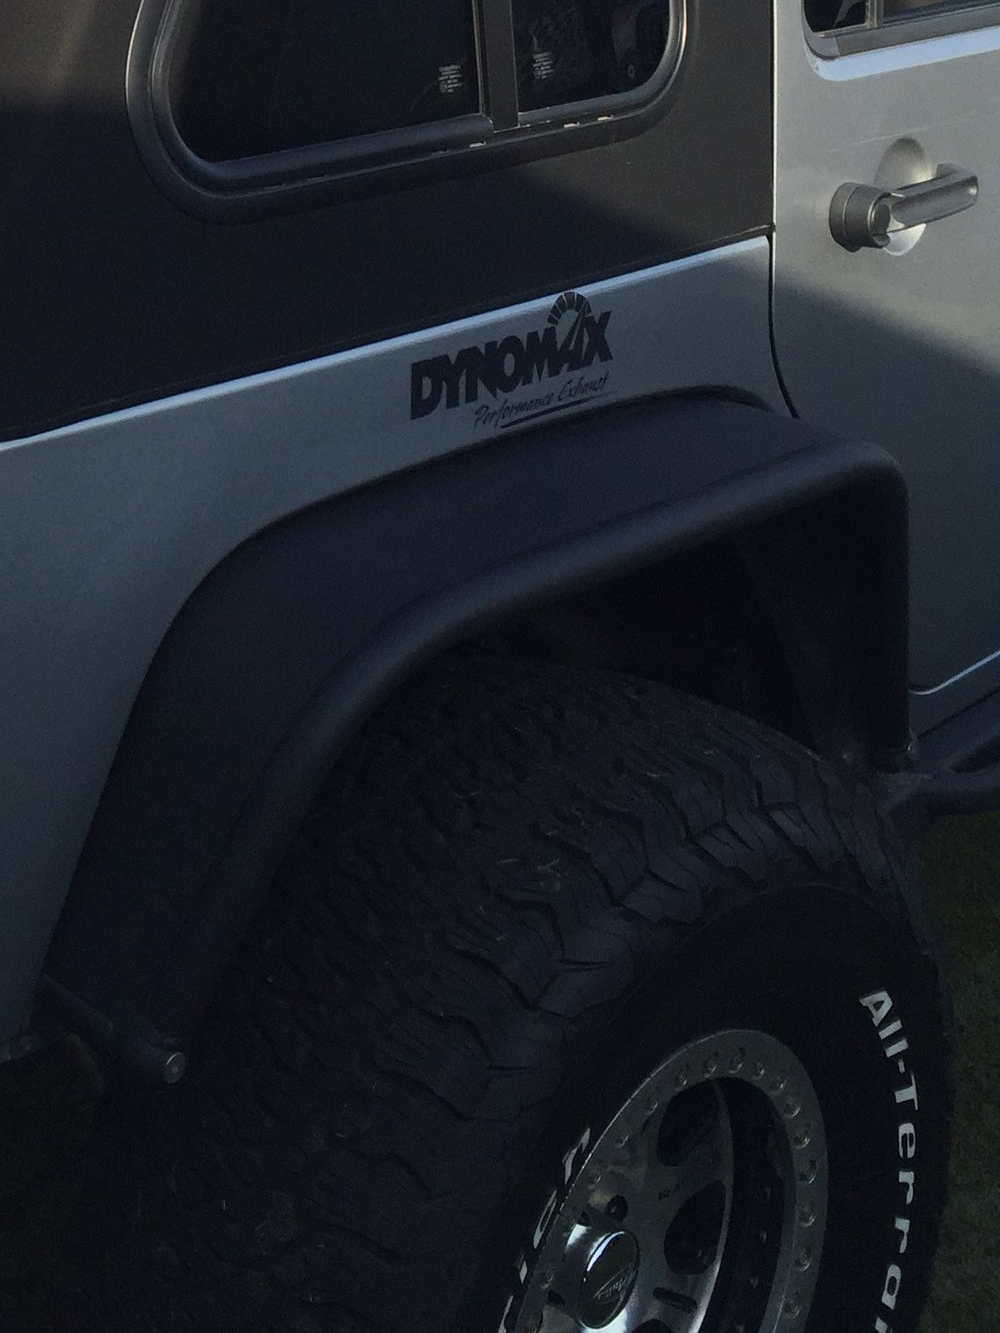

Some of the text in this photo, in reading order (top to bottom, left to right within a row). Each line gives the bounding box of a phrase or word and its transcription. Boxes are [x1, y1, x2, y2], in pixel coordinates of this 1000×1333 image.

[410, 303, 613, 421] DYNOMAX
[474, 370, 611, 429] Performance Exhaust
